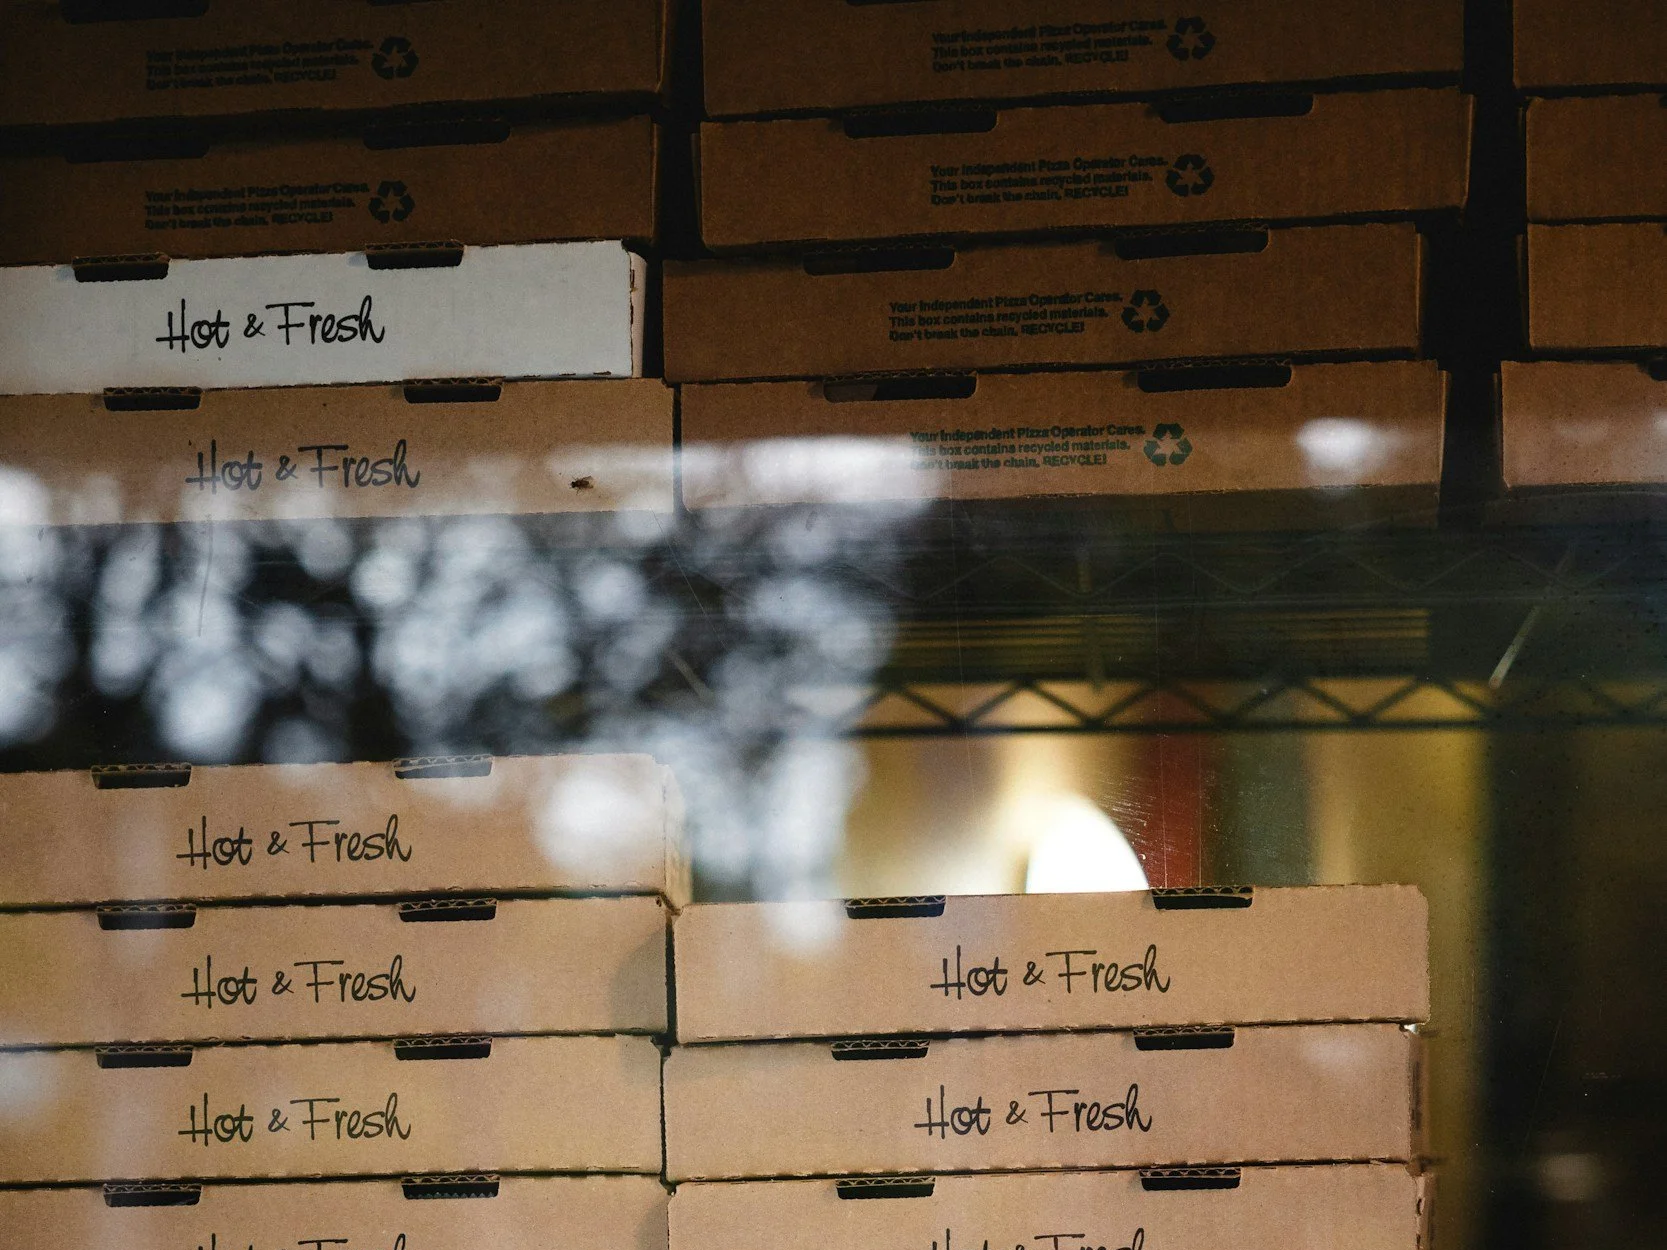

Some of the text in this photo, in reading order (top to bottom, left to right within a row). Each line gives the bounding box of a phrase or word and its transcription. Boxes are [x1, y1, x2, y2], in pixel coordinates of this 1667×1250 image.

[155, 294, 386, 354] Hot & Fresh
[889, 306, 1109, 327] This box contains recycled materials.
[890, 291, 1124, 312] Your Independent Pizza Operator Cares.
[923, 328, 958, 340] break
[958, 327, 979, 339] the
[1020, 322, 1085, 335] RECYCLE!
[912, 423, 1146, 441] Your Independent Pizza Operator Cares.
[939, 444, 963, 455] box
[963, 442, 1017, 454] contains
[1018, 440, 1070, 454] recycled
[1070, 438, 1131, 450] materials.
[184, 438, 422, 494] Hot & Fresh
[945, 458, 980, 470] break
[980, 457, 1001, 468] the
[1042, 453, 1107, 466] RECYCLE!
[175, 813, 413, 871] Hot & Fresh
[180, 954, 417, 1010] Hot & Fresh
[929, 943, 1171, 1001] Hot & Fresh
[177, 1091, 412, 1147] Hot & Fresh
[913, 1082, 1153, 1140] Hot & Fresh
